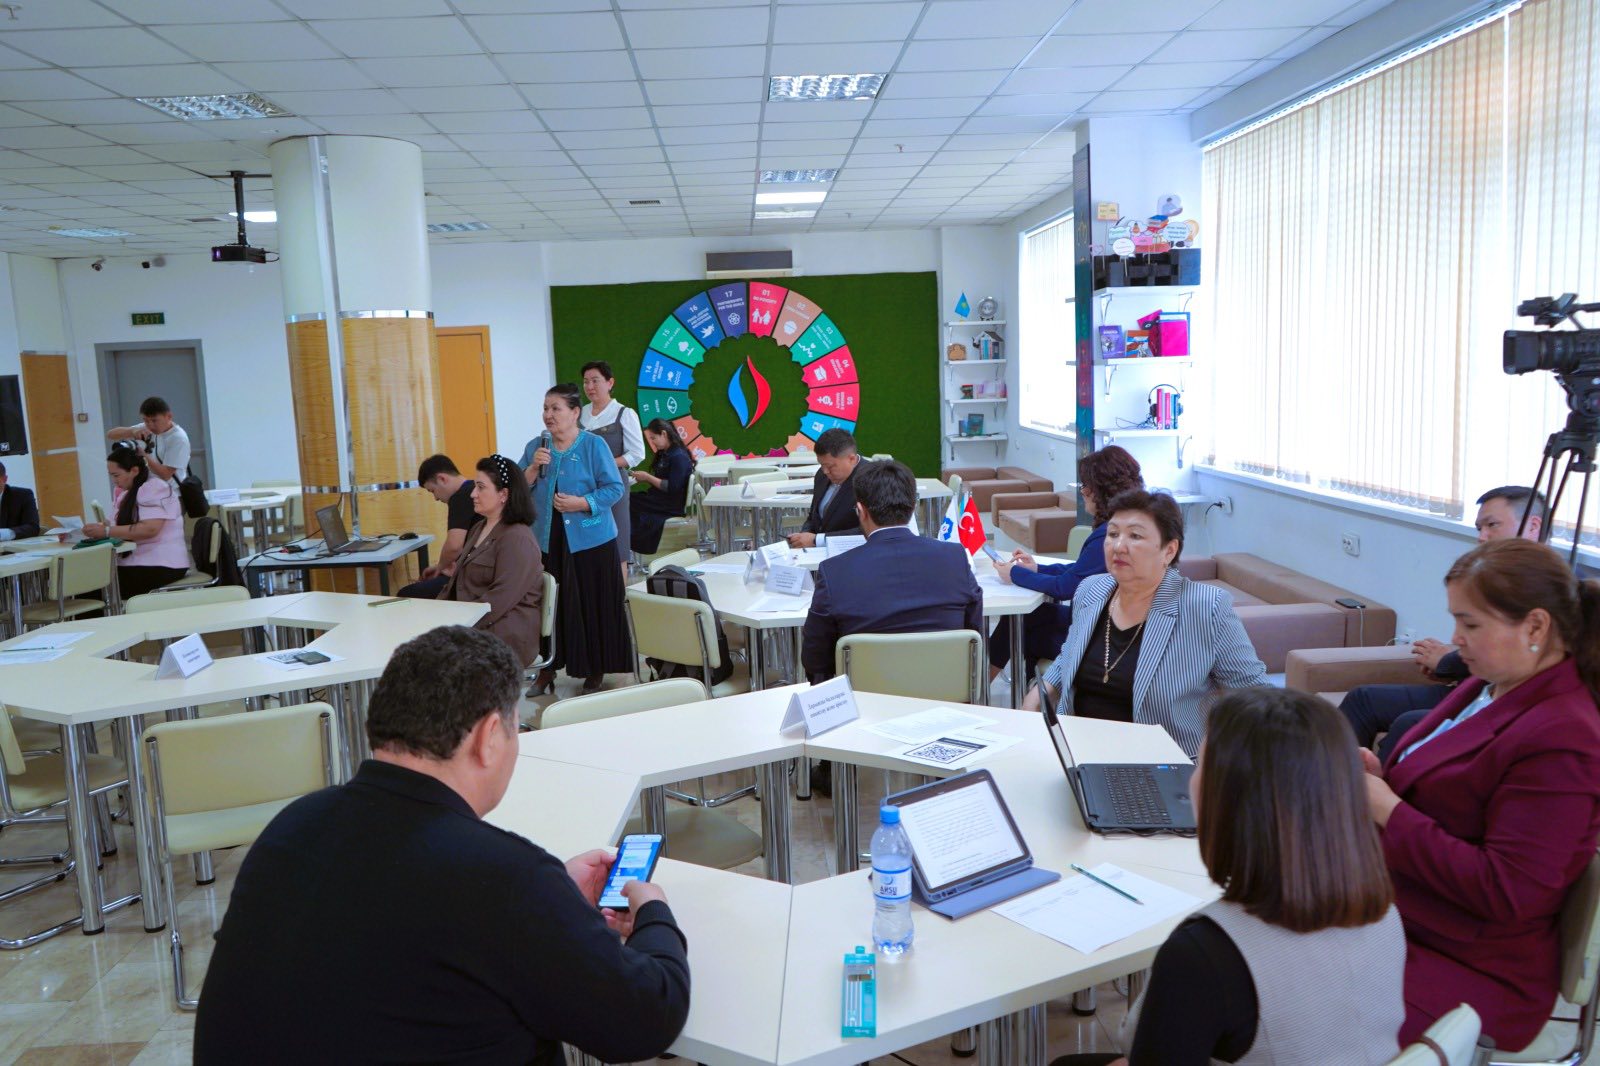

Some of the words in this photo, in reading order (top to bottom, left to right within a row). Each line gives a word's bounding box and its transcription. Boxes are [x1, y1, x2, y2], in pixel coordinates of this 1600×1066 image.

[135, 314, 160, 324] EXIT
[662, 328, 670, 337] 15
[826, 326, 833, 334] 03
[842, 360, 850, 368] 04
